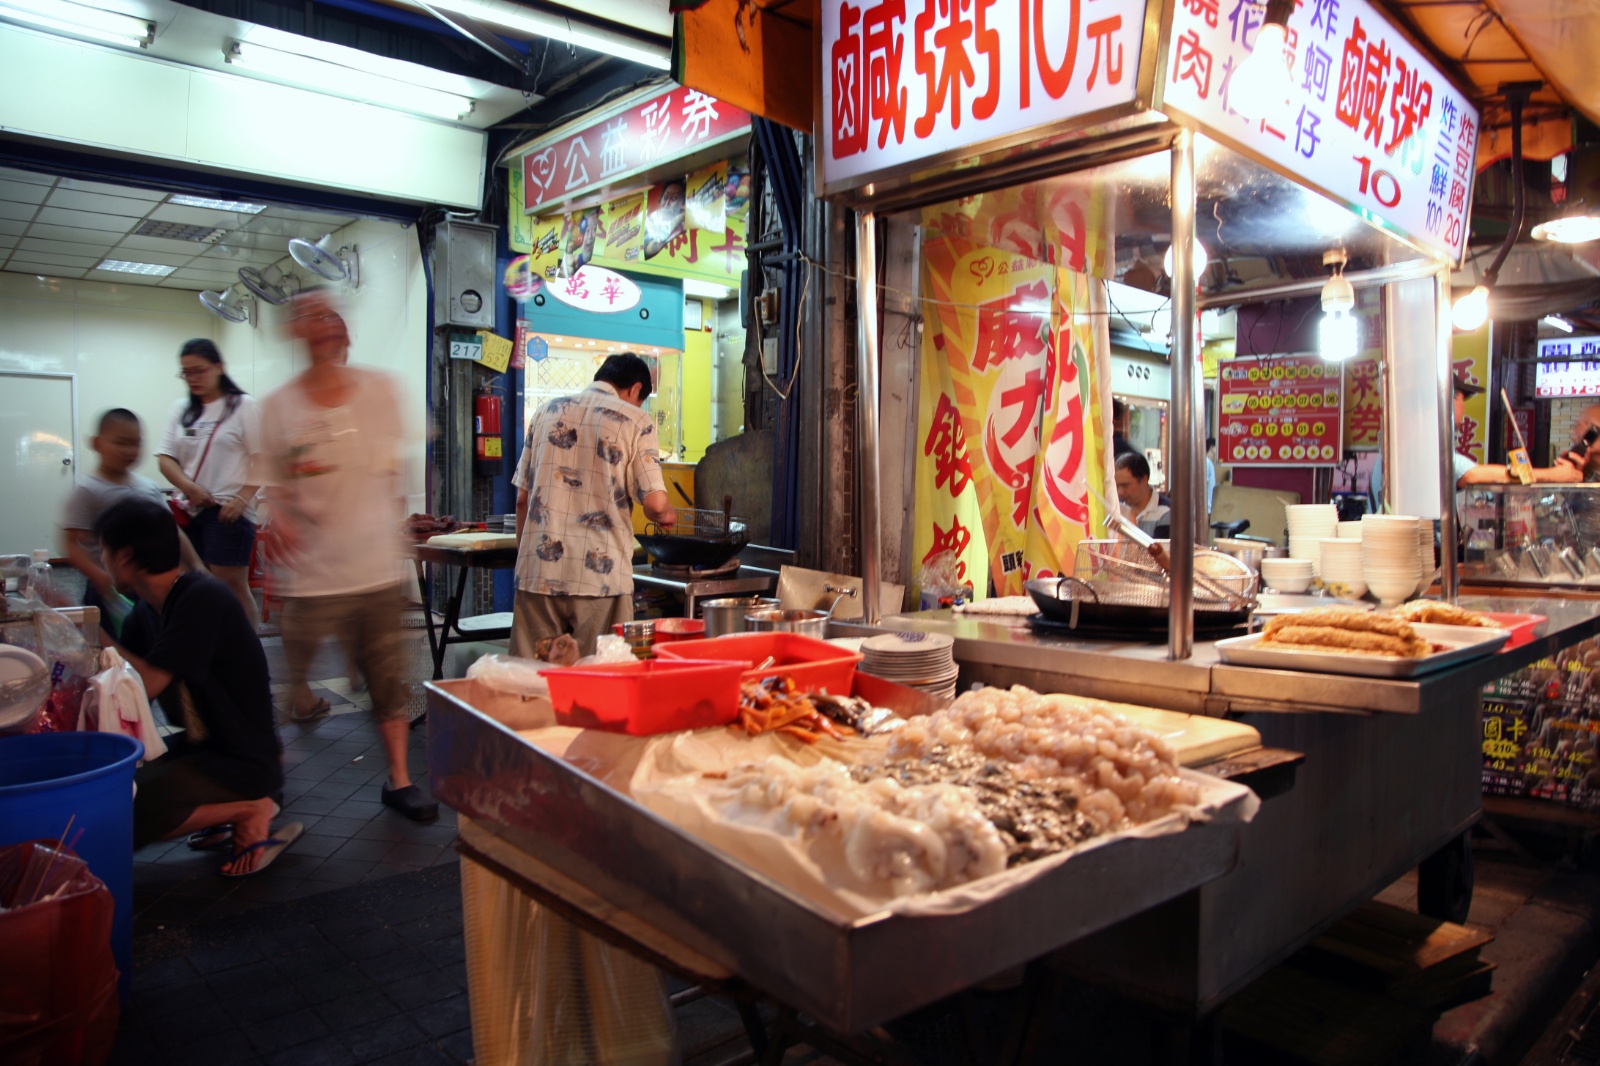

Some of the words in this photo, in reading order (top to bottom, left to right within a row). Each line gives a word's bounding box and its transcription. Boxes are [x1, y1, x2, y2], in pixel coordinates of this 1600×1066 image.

[1335, 16, 1433, 177] 鹹粥
[563, 88, 719, 191] 公益彩券
[1352, 153, 1402, 209] 10
[452, 343, 481, 358] 217
